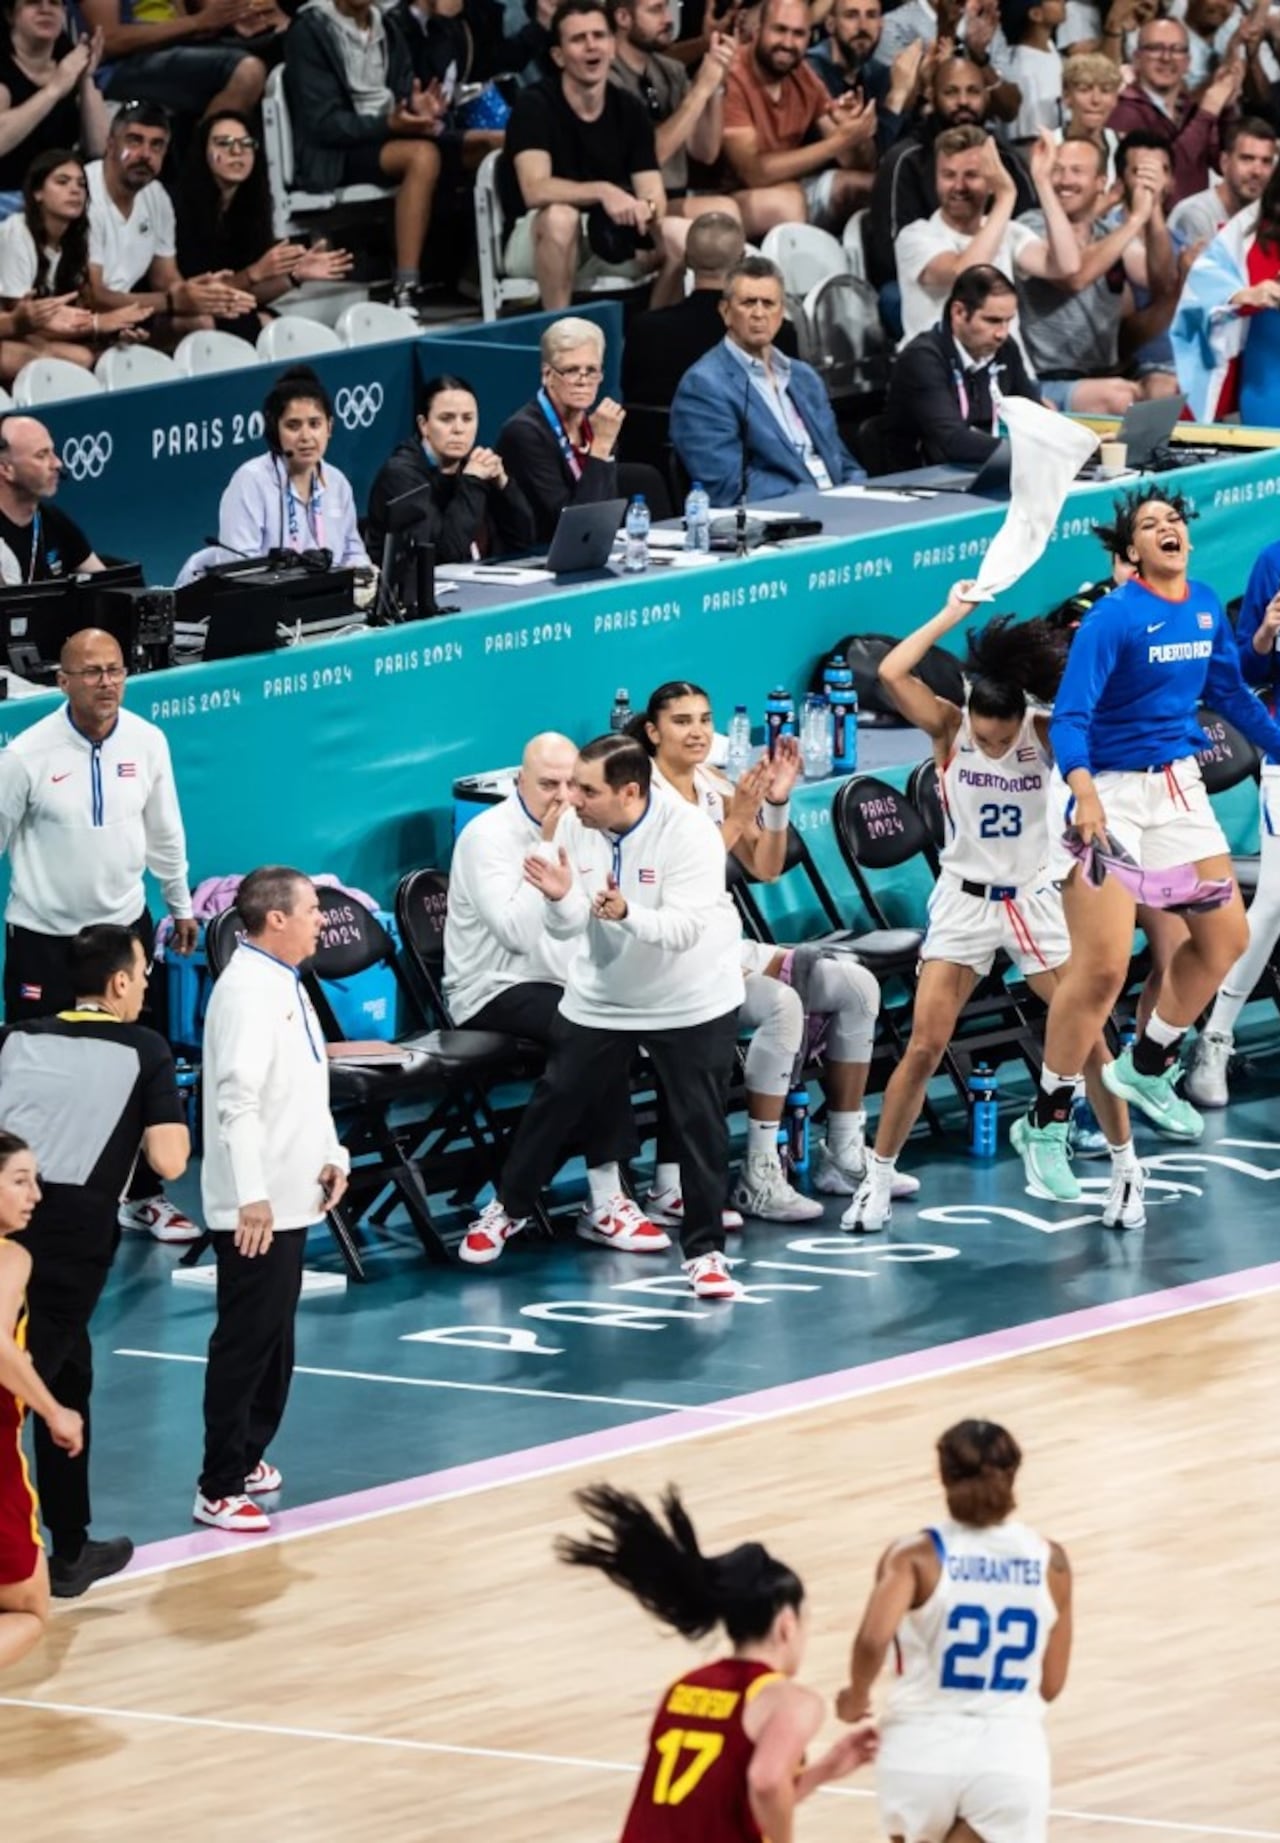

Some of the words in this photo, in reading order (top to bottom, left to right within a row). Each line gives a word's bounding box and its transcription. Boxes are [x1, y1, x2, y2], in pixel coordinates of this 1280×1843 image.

[152, 417, 223, 459] PARIS
[232, 410, 265, 445] 20
[959, 537, 991, 561] 202
[854, 557, 892, 582] 2024
[749, 579, 788, 603] 2024
[642, 601, 680, 626] 2024
[533, 621, 572, 645] 2024
[424, 642, 463, 667] 2024
[313, 664, 353, 689] 2024
[201, 688, 241, 712] 2024
[959, 768, 1009, 791] PUERTO
[1009, 775, 1043, 793] RICO
[867, 817, 905, 840] 2024
[980, 803, 1022, 838] 23
[320, 925, 361, 948] 2024
[948, 1556, 1041, 1585] GUIRANTES
[940, 1603, 1038, 1693] 22
[653, 1728, 725, 1806] 17
